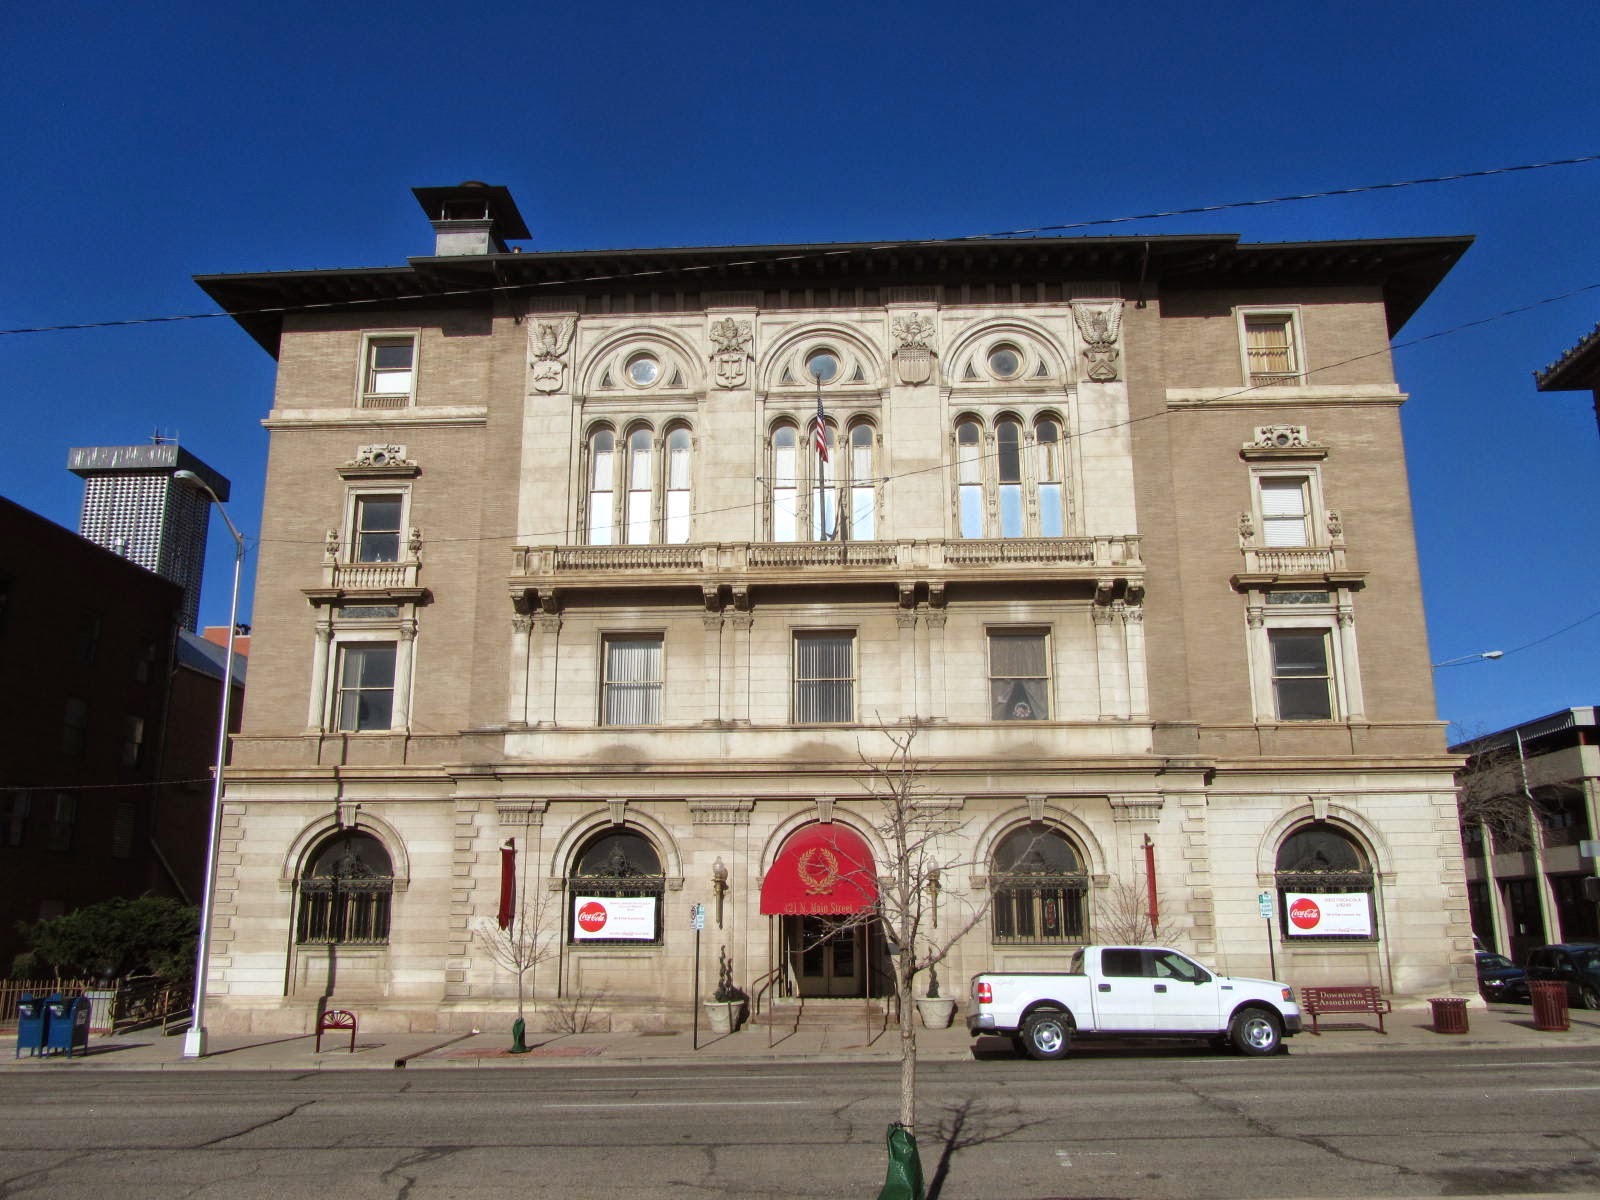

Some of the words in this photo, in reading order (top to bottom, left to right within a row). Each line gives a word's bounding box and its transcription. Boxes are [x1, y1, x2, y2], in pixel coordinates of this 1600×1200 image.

[800, 903, 808, 913] N.
[811, 902, 828, 914] Main
[831, 902, 853, 913] Street
[1291, 908, 1319, 919] Coca-Cola
[578, 911, 606, 922] Coca-Cola
[1320, 998, 1366, 1006] Association
